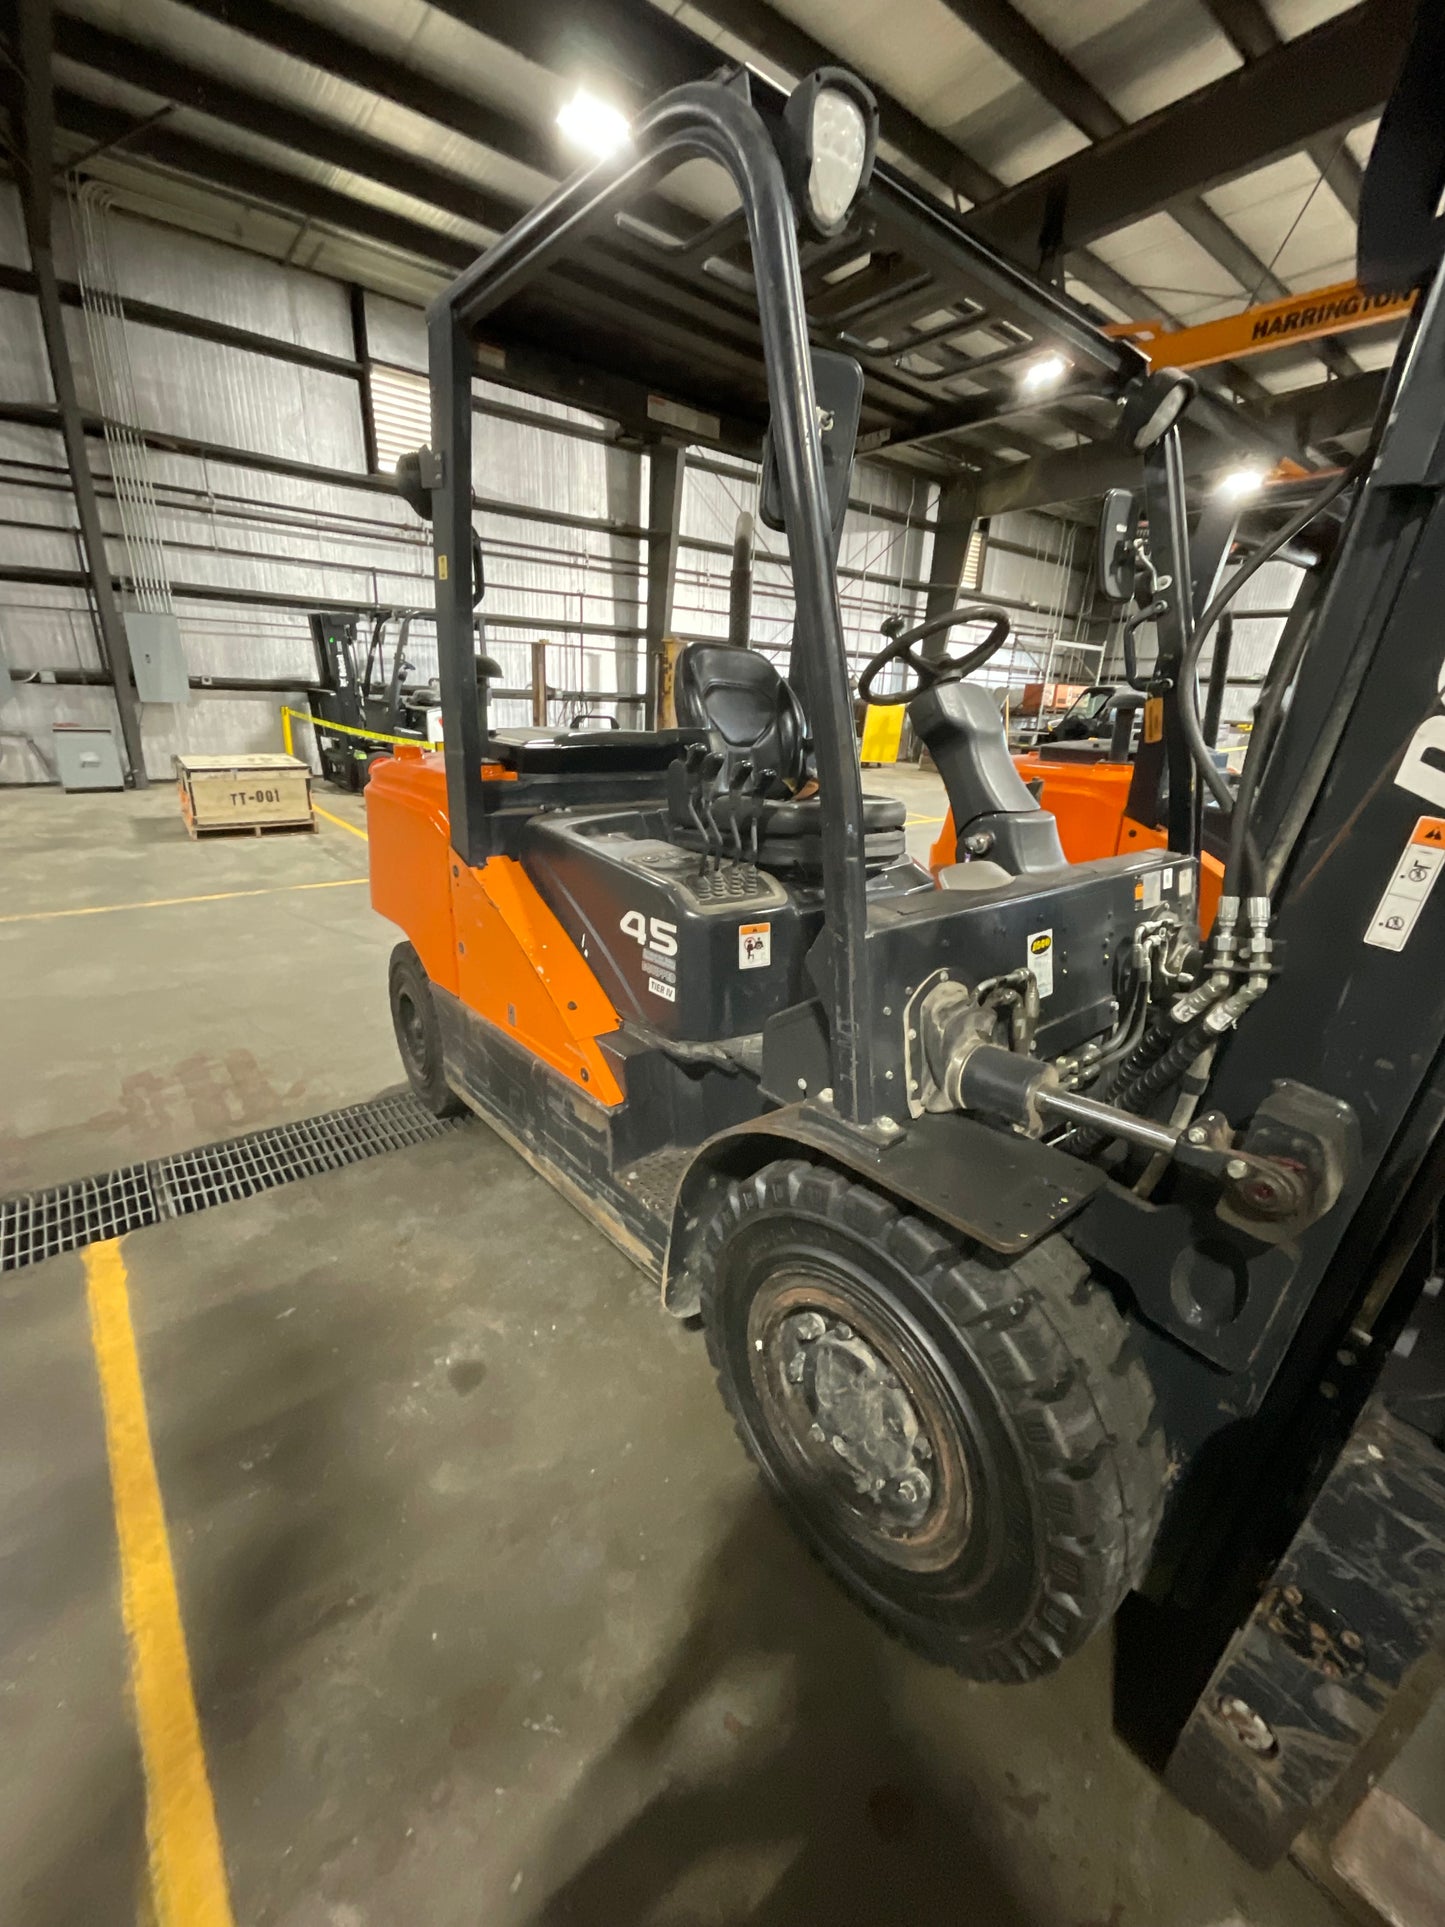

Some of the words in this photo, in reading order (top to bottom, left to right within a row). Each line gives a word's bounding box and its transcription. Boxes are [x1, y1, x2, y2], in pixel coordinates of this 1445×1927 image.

[230, 789, 280, 806] TT-001
[620, 910, 677, 956] 45
[651, 981, 665, 994] TIER
[665, 987, 674, 998] IV
